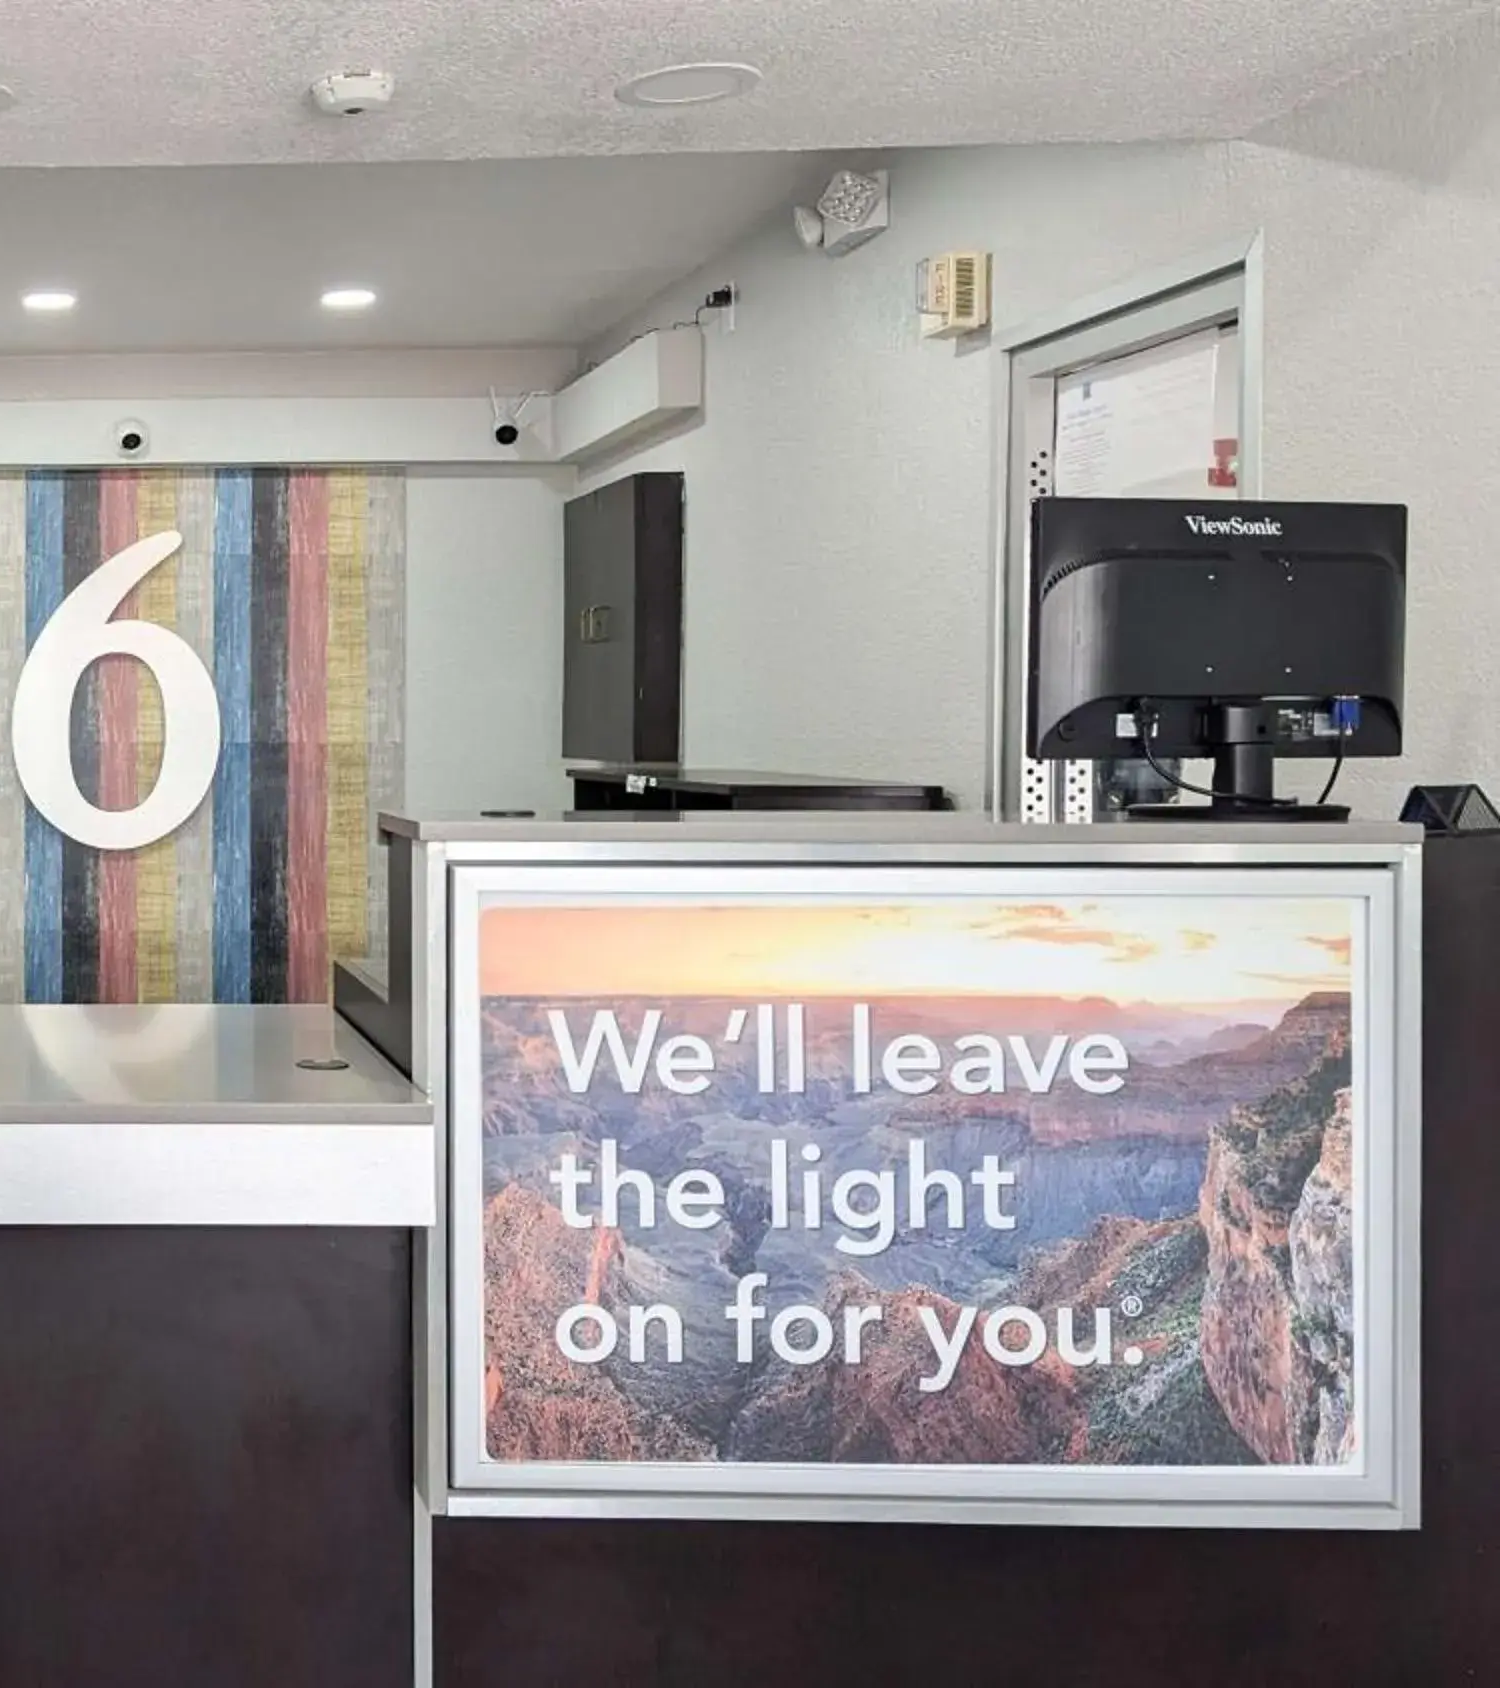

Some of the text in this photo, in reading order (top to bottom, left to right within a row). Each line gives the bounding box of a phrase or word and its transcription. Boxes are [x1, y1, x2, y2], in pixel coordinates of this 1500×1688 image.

[1184, 514, 1283, 536] ViewSonic
[12, 529, 221, 850] 6
[547, 1003, 1130, 1095] We’ll leave
[549, 1138, 1017, 1256] the light
[555, 1302, 684, 1364] on
[725, 1272, 884, 1365] for
